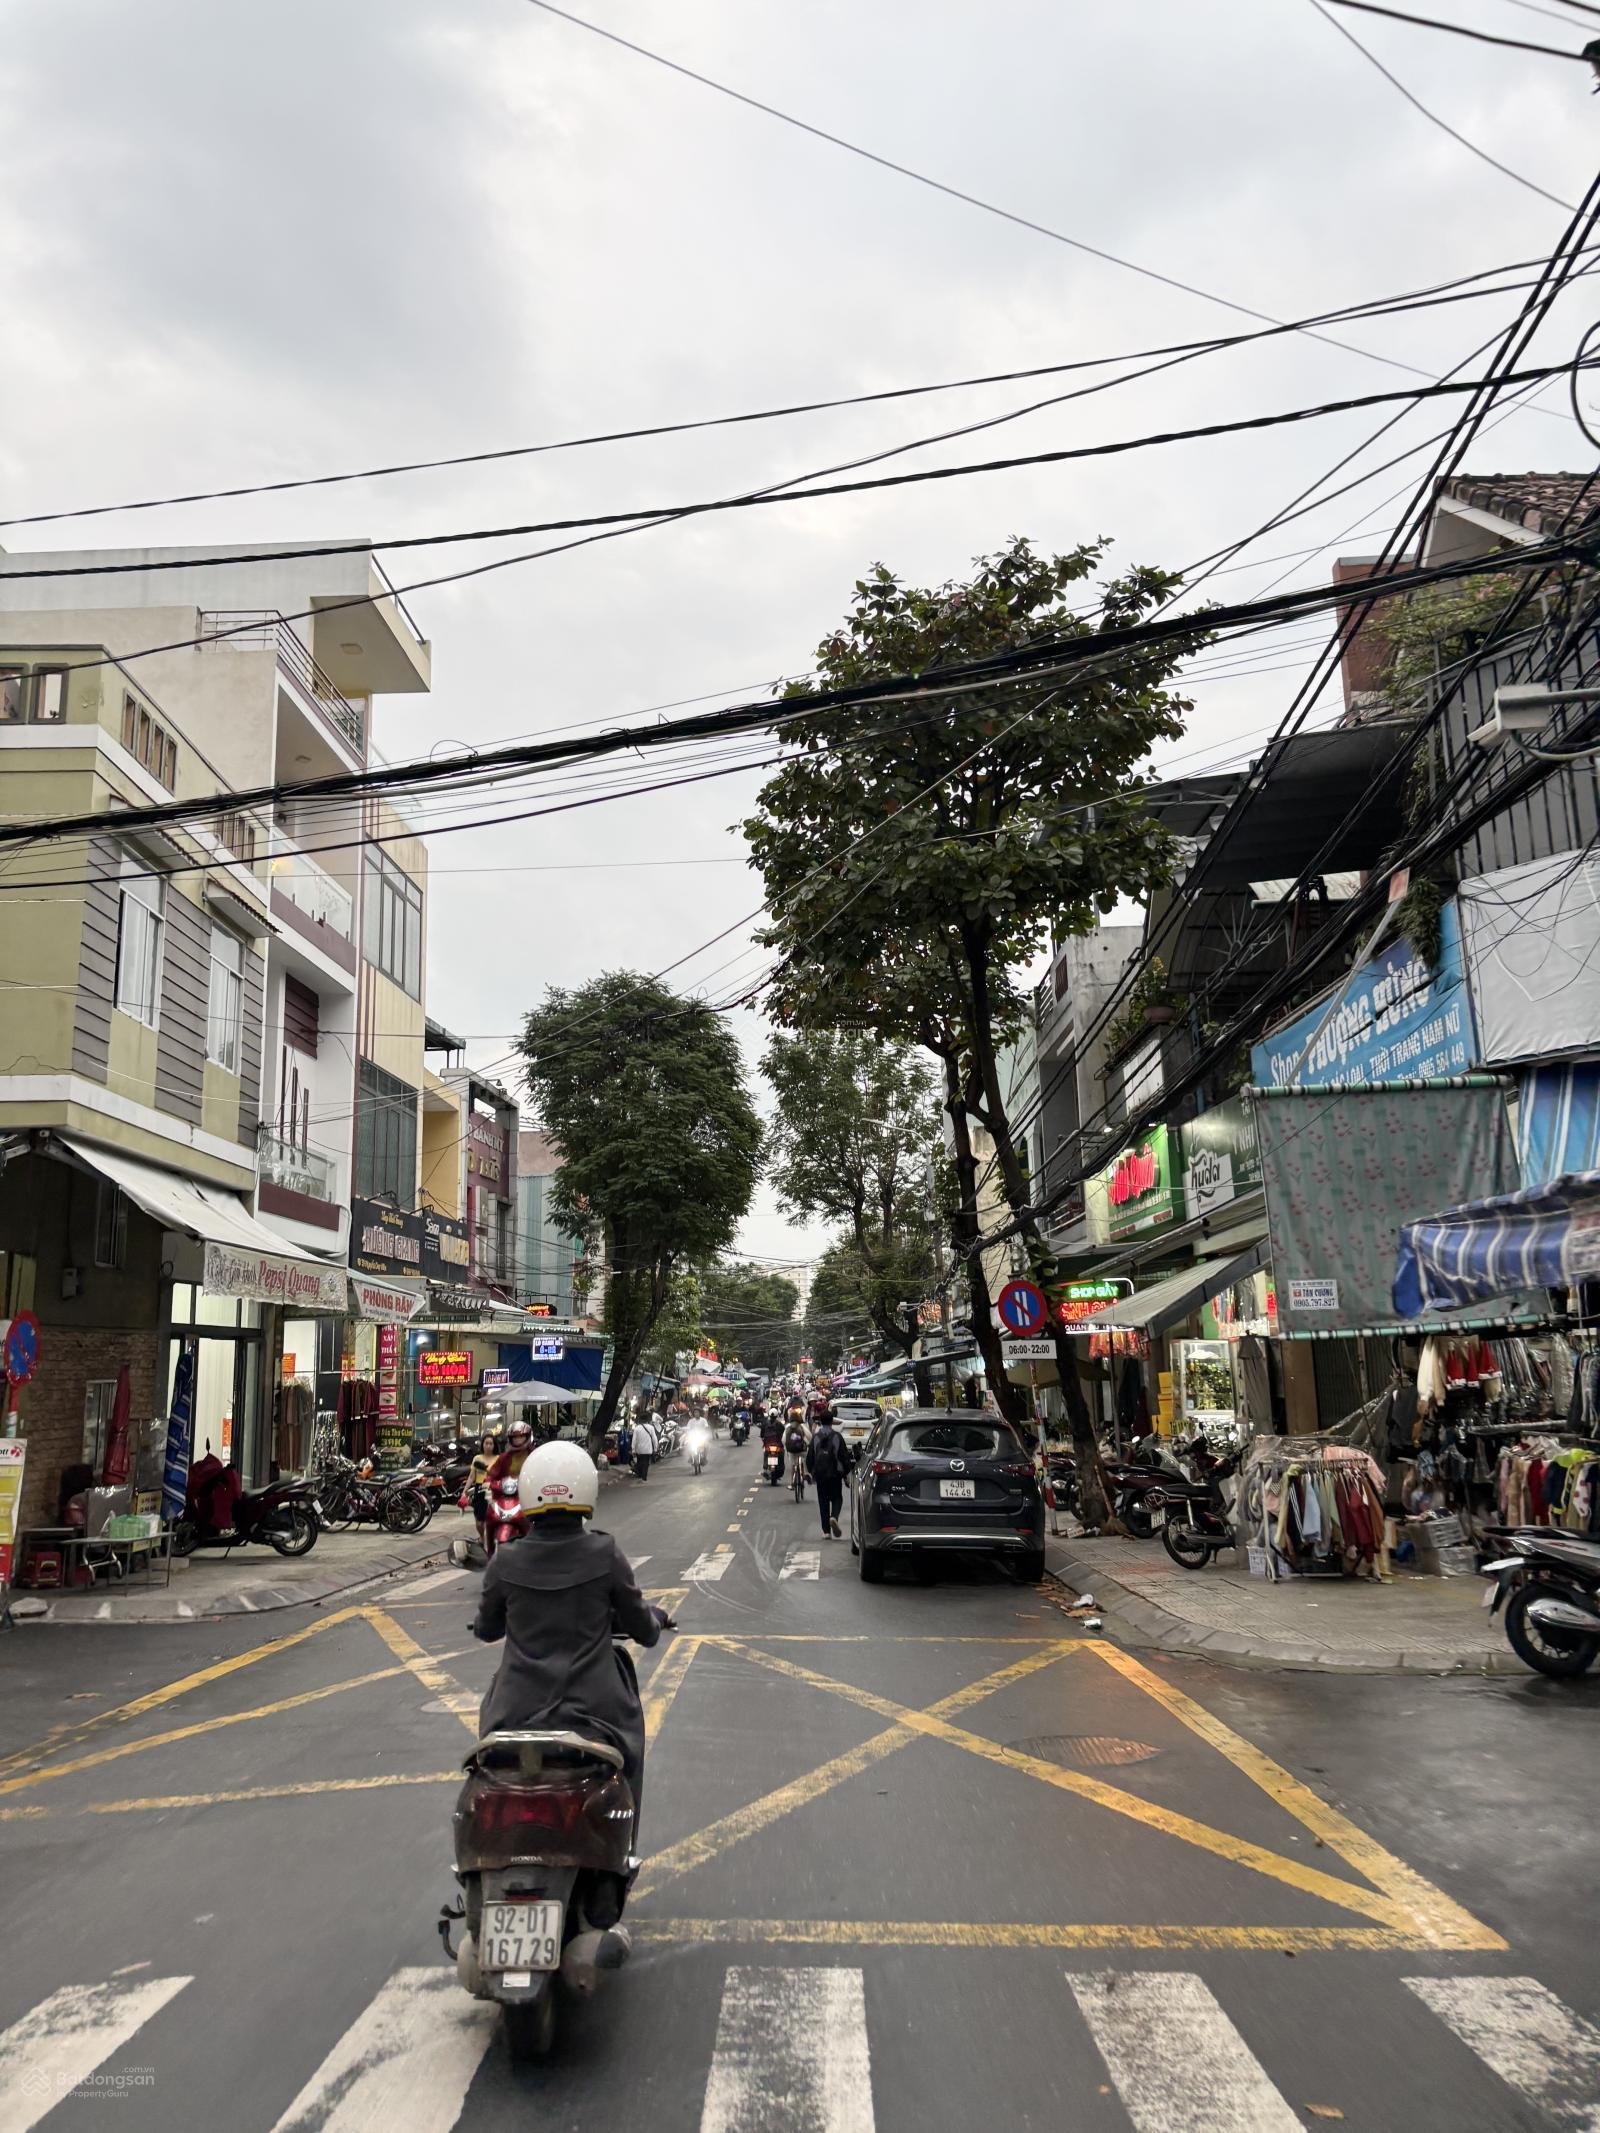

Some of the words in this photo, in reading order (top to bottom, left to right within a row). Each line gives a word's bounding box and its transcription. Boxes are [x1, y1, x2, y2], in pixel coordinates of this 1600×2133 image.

[1391, 1032, 1422, 1067] TRANG
[1422, 1017, 1445, 1051] NAM
[363, 1288, 394, 1311] PHÒNG
[1070, 1287, 1095, 1298] SHOP
[510, 1855, 543, 1863] HONDA
[494, 1906, 548, 1935] 92-D1
[487, 1938, 555, 1965] 167.29
